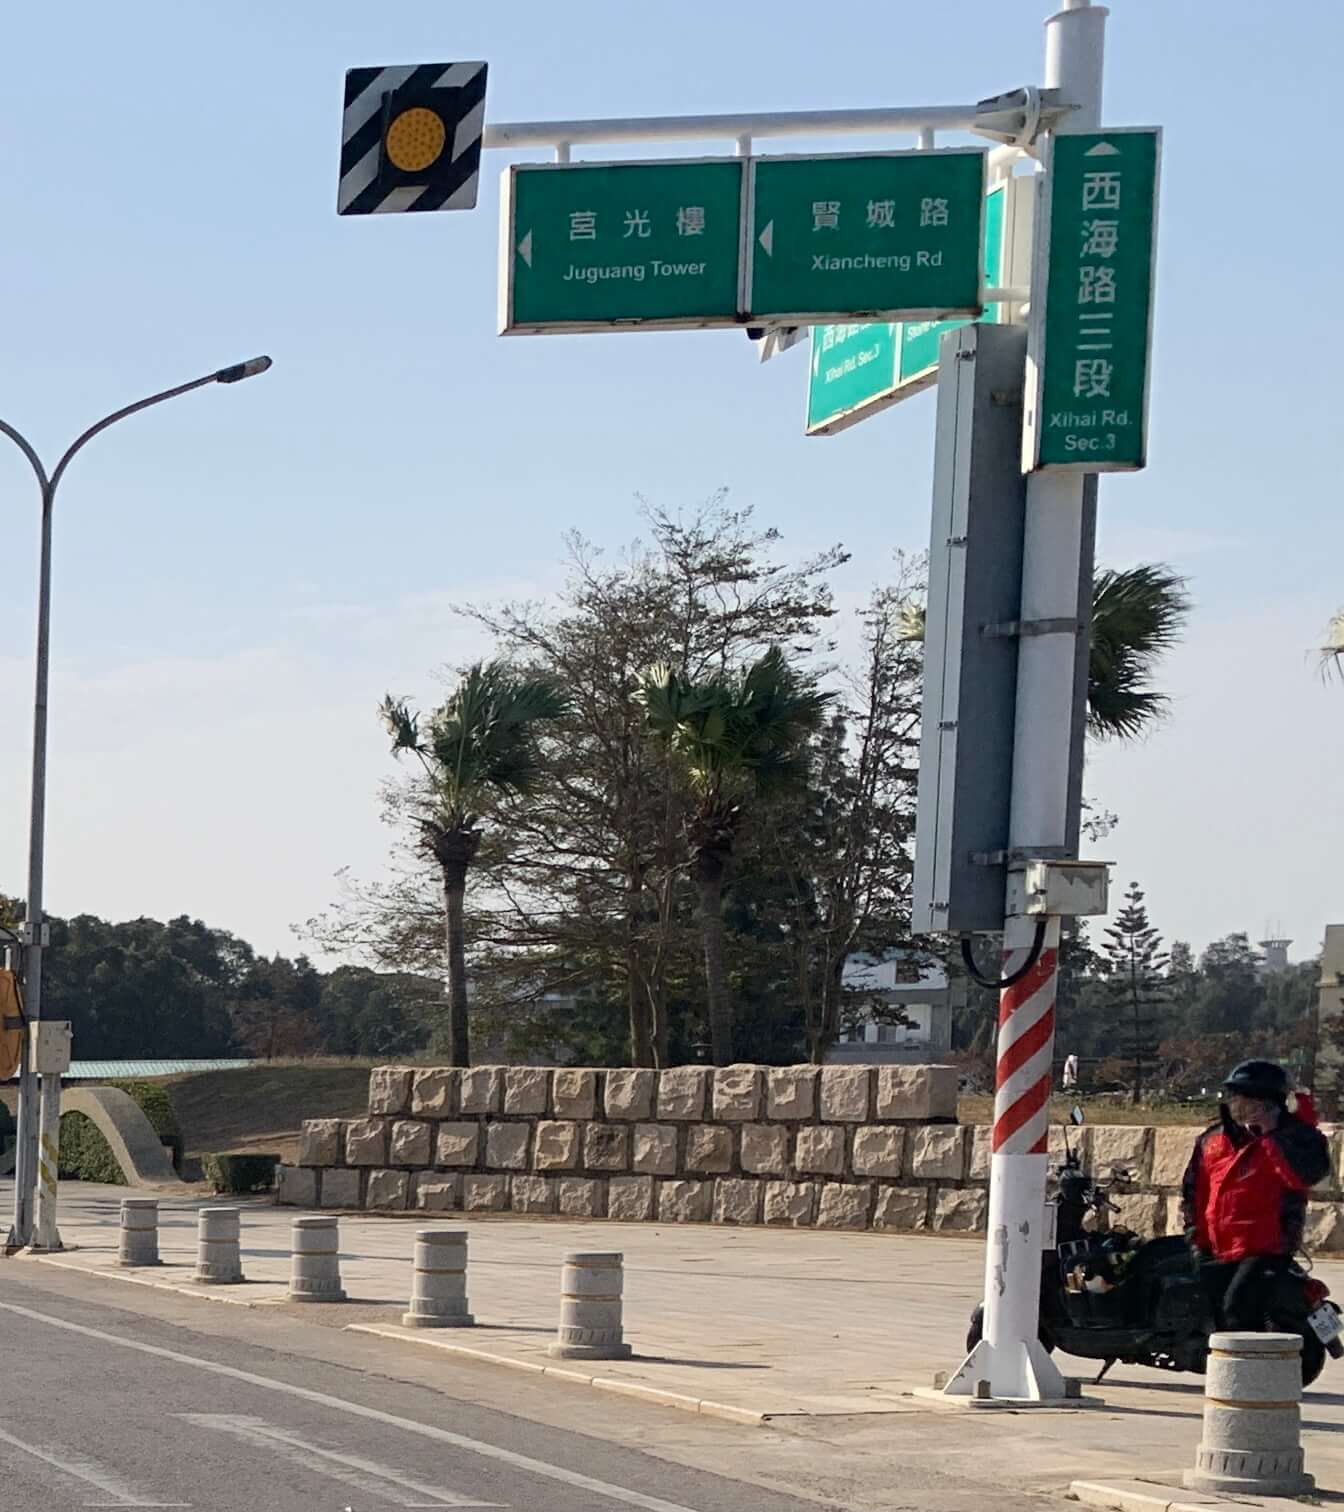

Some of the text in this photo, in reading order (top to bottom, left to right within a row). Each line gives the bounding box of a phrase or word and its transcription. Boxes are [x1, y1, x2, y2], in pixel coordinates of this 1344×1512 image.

[568, 206, 706, 241] 莒光樓
[811, 197, 950, 232] 賢城路
[562, 260, 707, 284] Juguang Tower
[811, 250, 943, 272] Xiancheng Rd
[1073, 171, 1122, 398] 西海路三段
[1049, 409, 1133, 428] Xihai Rd.
